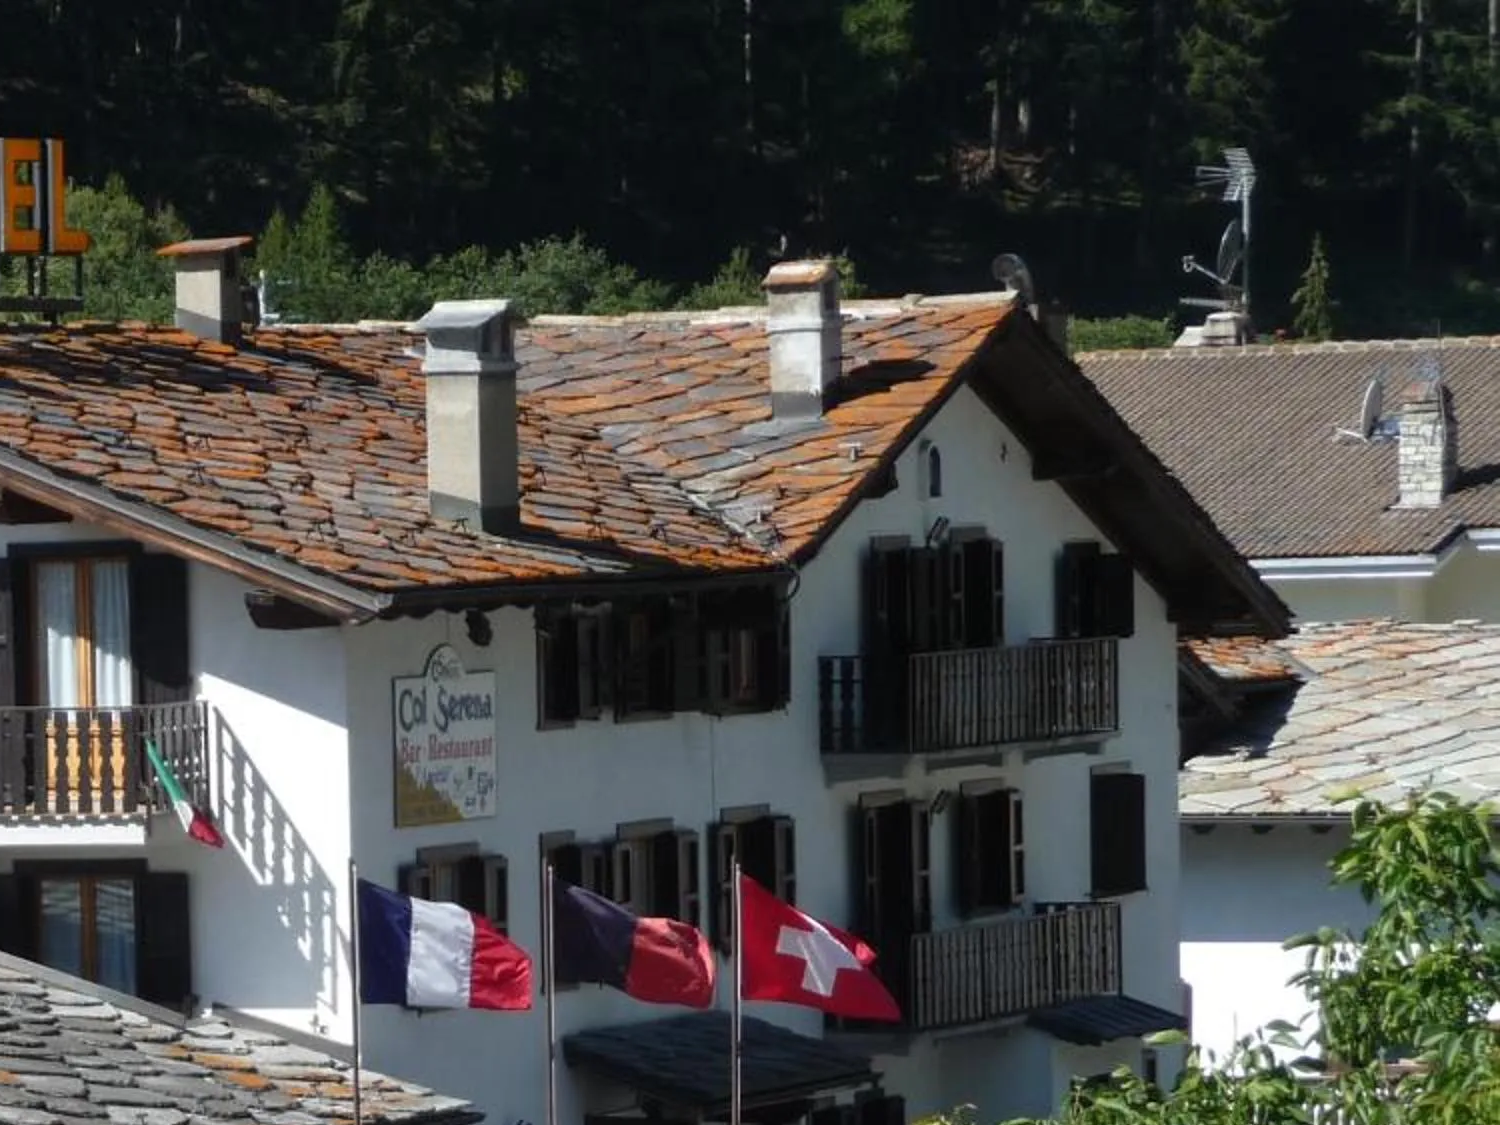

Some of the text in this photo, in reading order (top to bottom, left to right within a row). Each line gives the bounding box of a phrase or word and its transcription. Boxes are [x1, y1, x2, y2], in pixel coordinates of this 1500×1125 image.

[400, 685, 493, 733] Col Serena
[428, 733, 493, 761] Restaurant
